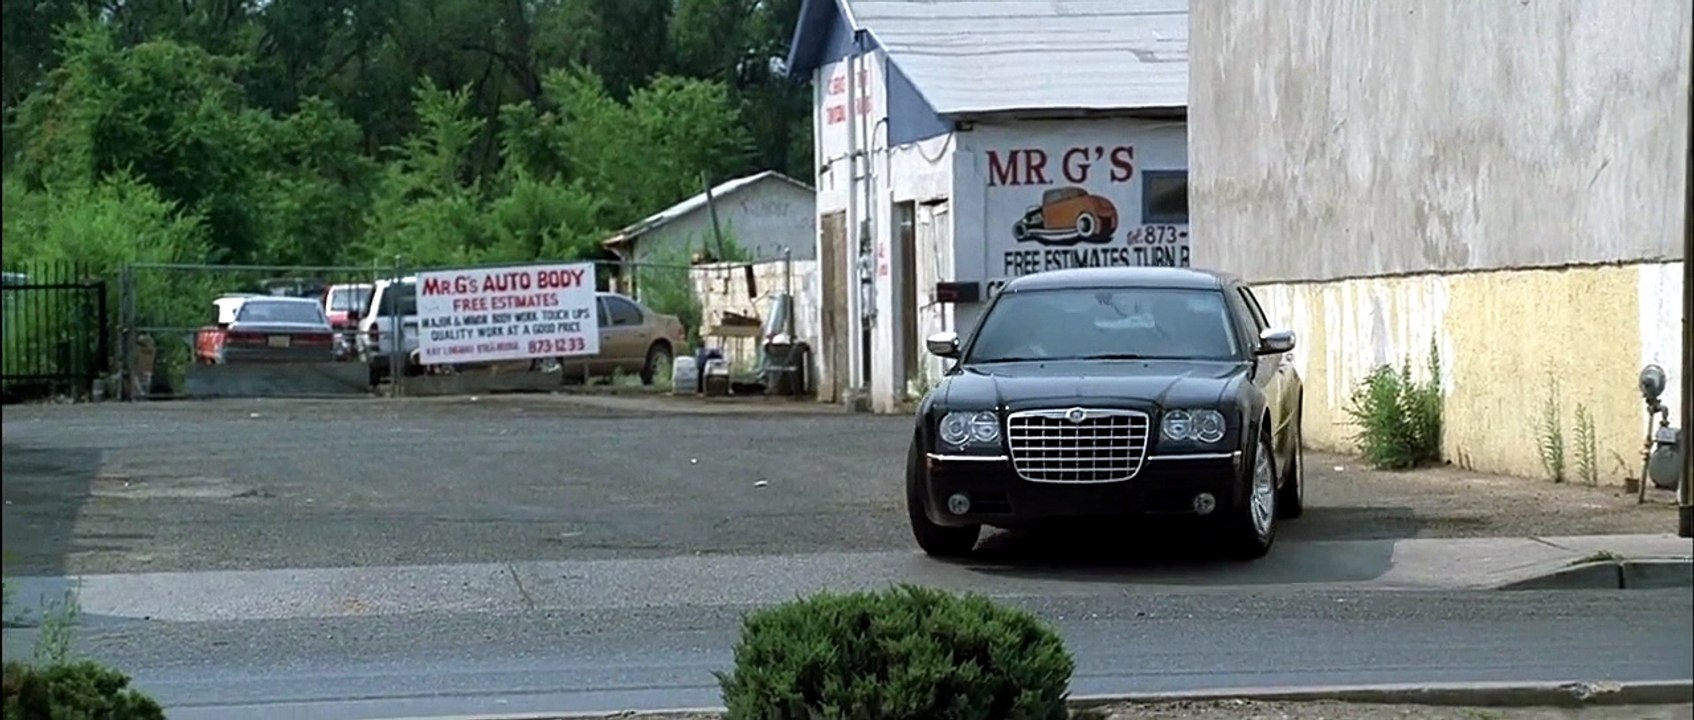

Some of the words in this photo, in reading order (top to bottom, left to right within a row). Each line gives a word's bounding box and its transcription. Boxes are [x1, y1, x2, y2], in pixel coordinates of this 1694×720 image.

[987, 148, 1053, 187] MR.
[1062, 146, 1134, 184] G'S
[1004, 250, 1040, 276] FREE
[1045, 247, 1129, 273] ESTIMATES
[1133, 246, 1175, 267] TURN
[482, 271, 531, 292] AUTO
[538, 269, 585, 289] BODY
[453, 297, 488, 312] FREE
[491, 293, 559, 311] ESTIMATES
[421, 315, 451, 328] MAJOR
[515, 311, 538, 322] WORK
[541, 309, 570, 321] TOUCH
[431, 328, 473, 341] QUALITY
[478, 326, 504, 338] WORK
[507, 324, 520, 336] AT
[523, 324, 531, 336] A
[532, 322, 556, 335] GOOD
[558, 321, 581, 333] PRICE
